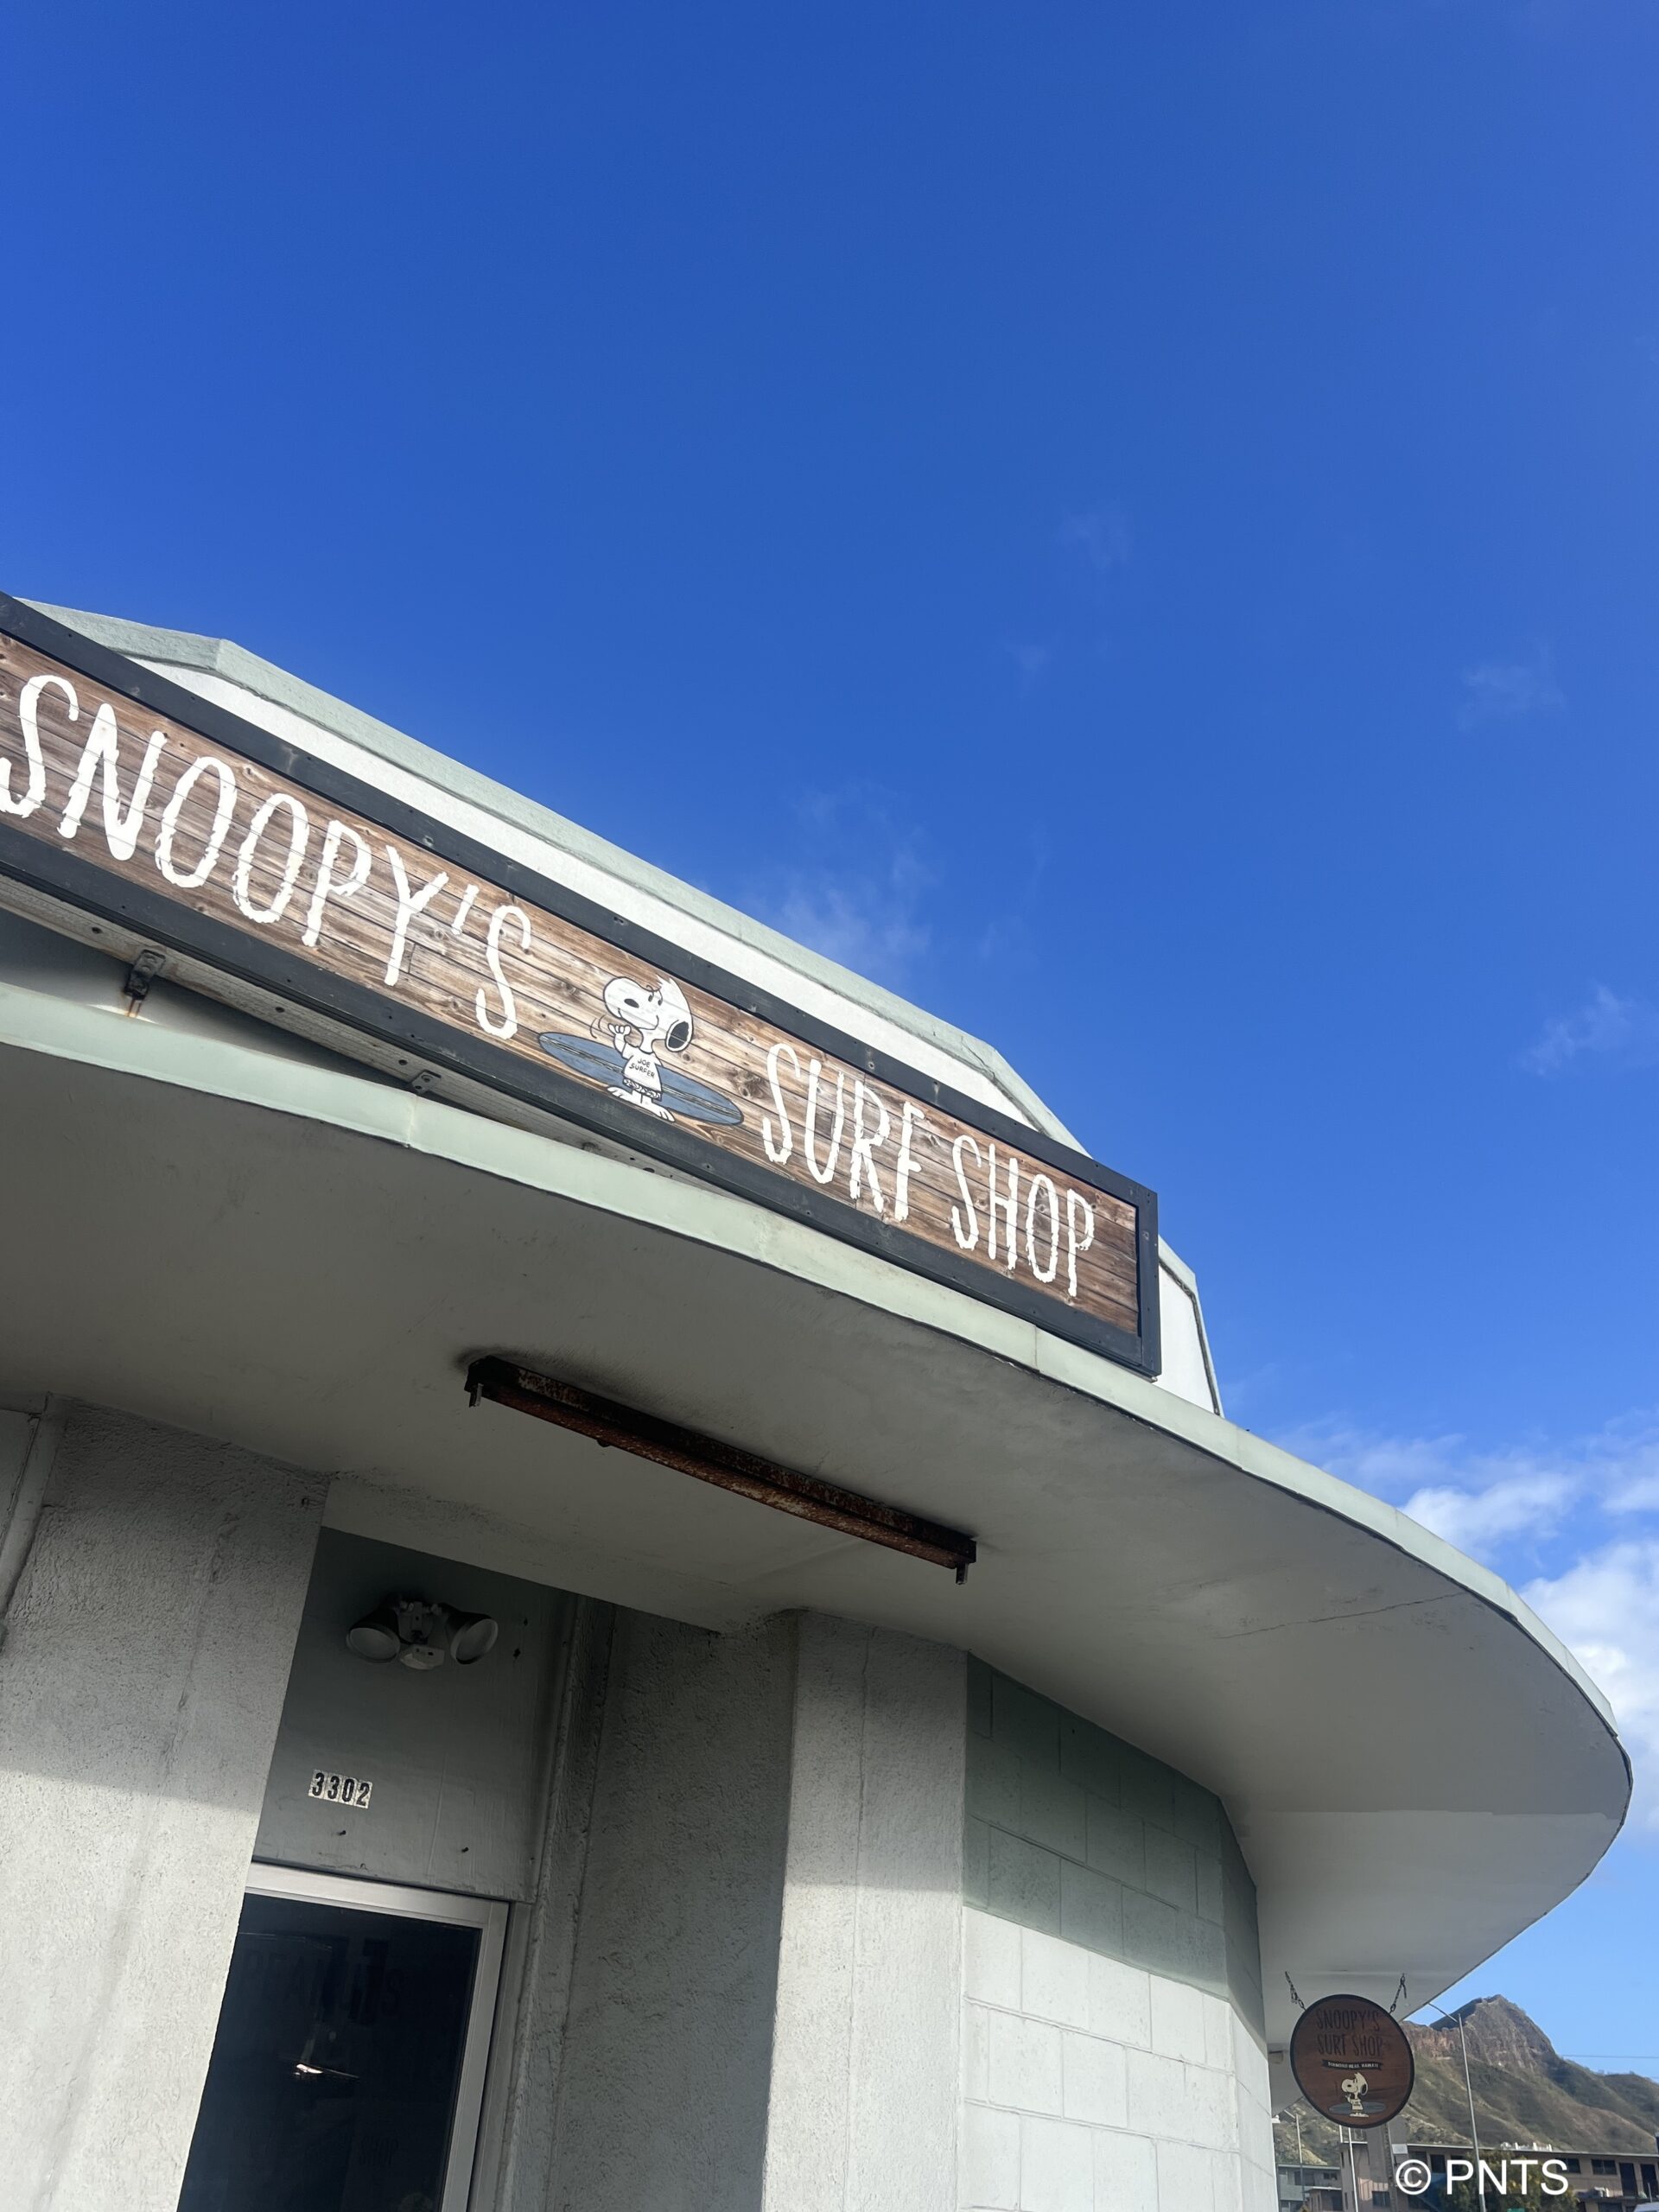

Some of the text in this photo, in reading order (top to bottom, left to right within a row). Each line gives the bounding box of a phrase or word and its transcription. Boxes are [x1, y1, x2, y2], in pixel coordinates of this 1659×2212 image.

[0, 675, 1095, 1297] SNOOPY'S SURF SHOP
[629, 1063, 655, 1078] SURFER
[638, 1058, 651, 1068] JOE
[312, 1772, 370, 1806] 3302
[1316, 2009, 1381, 2031] SNOOPY'S
[1317, 2034, 1382, 2056] SURF SHOP
